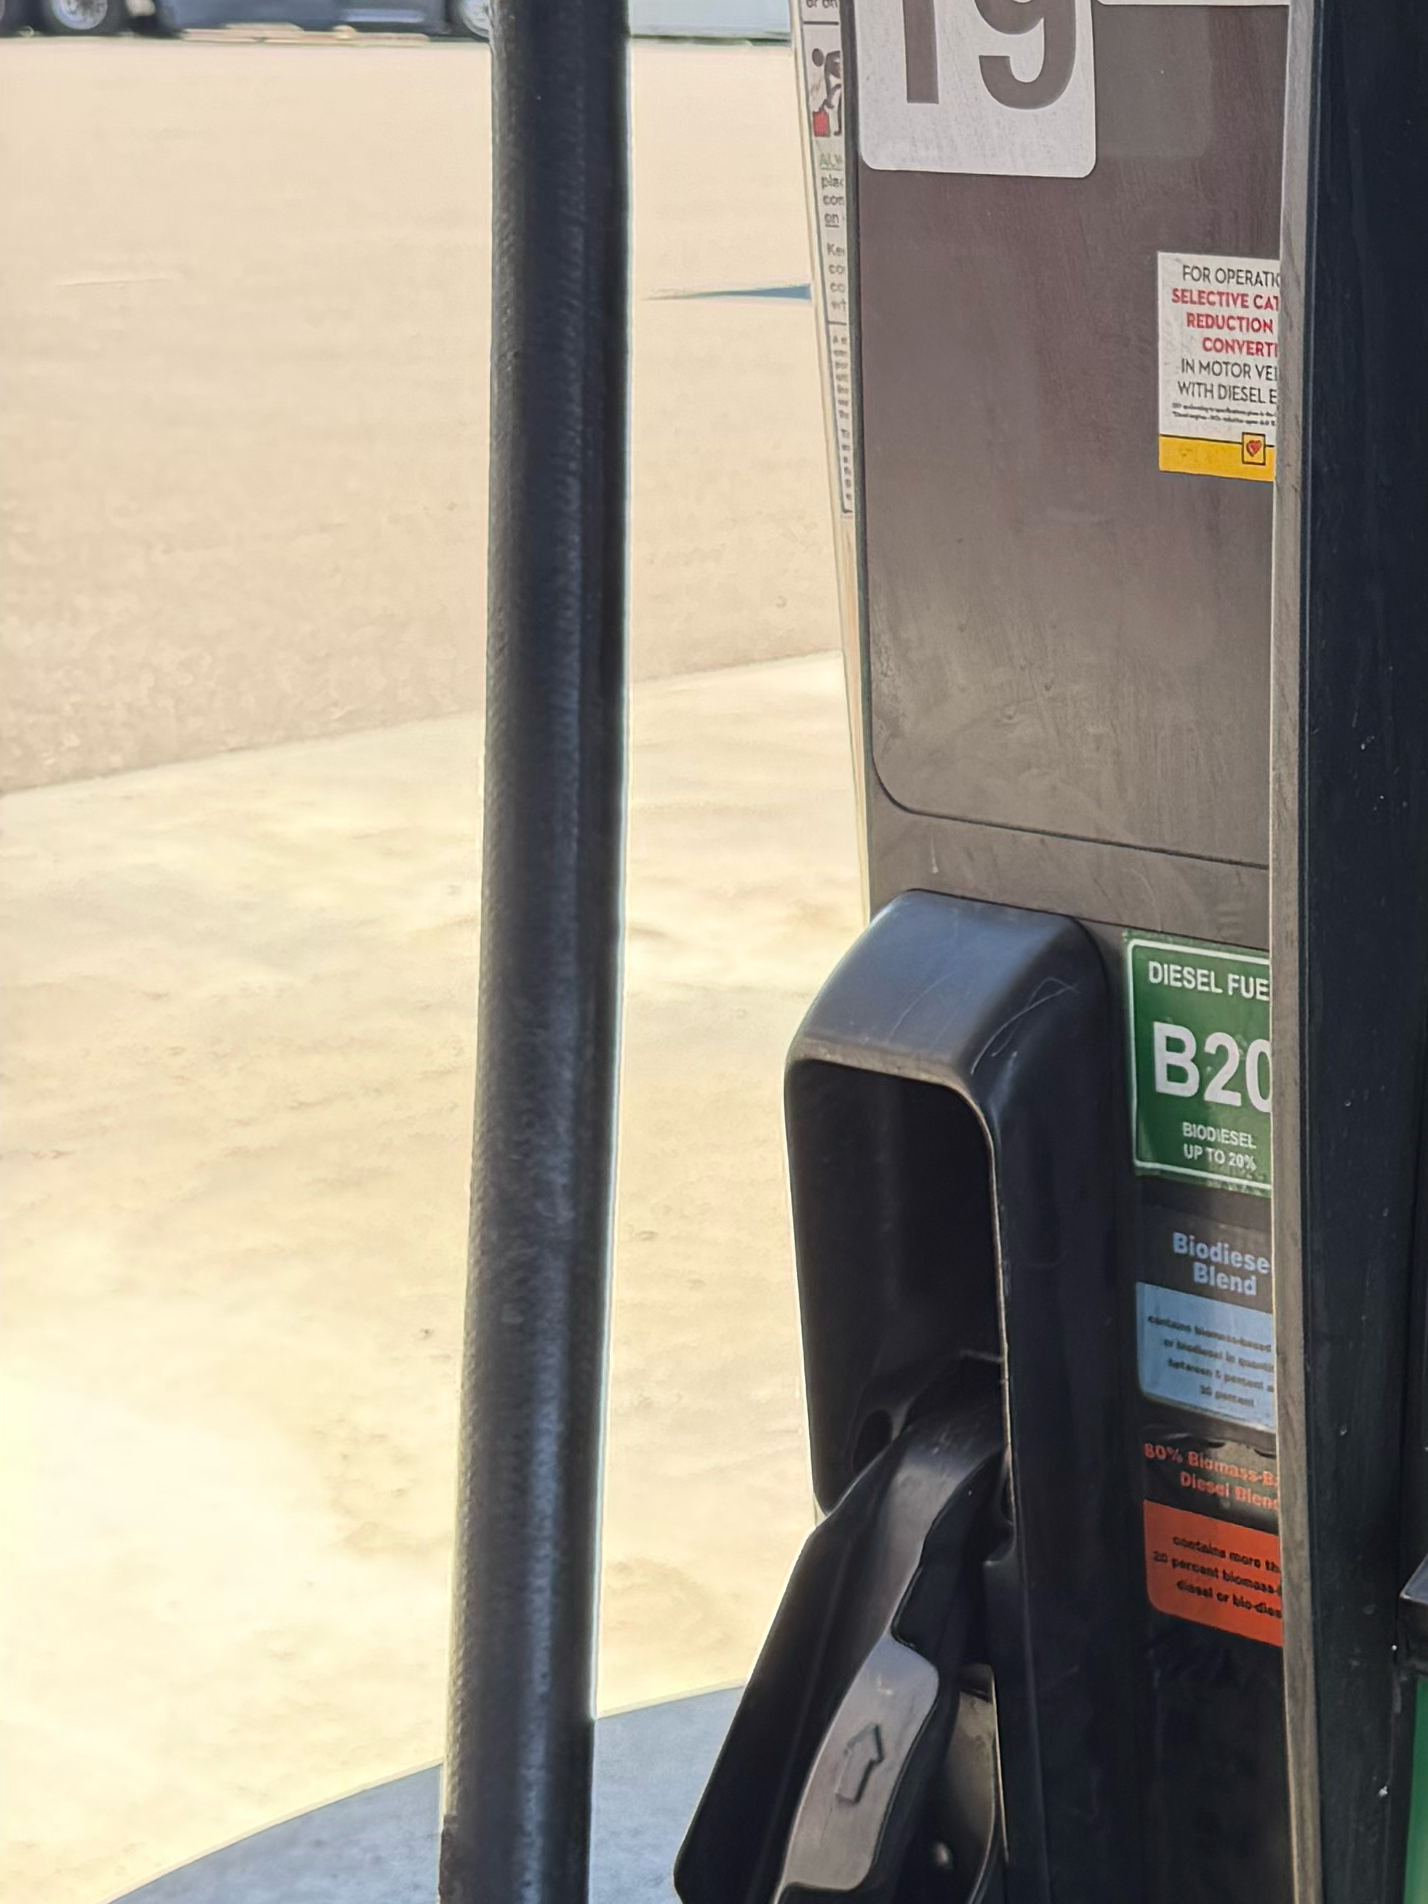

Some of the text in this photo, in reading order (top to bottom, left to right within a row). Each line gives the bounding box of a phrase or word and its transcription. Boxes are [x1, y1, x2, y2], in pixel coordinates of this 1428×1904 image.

[1149, 961, 1223, 994] DIESEL
[1182, 1121, 1257, 1149] BIODIESEL
[1183, 1143, 1257, 1171] UP TO 20%
[1193, 1261, 1258, 1297] Blend
